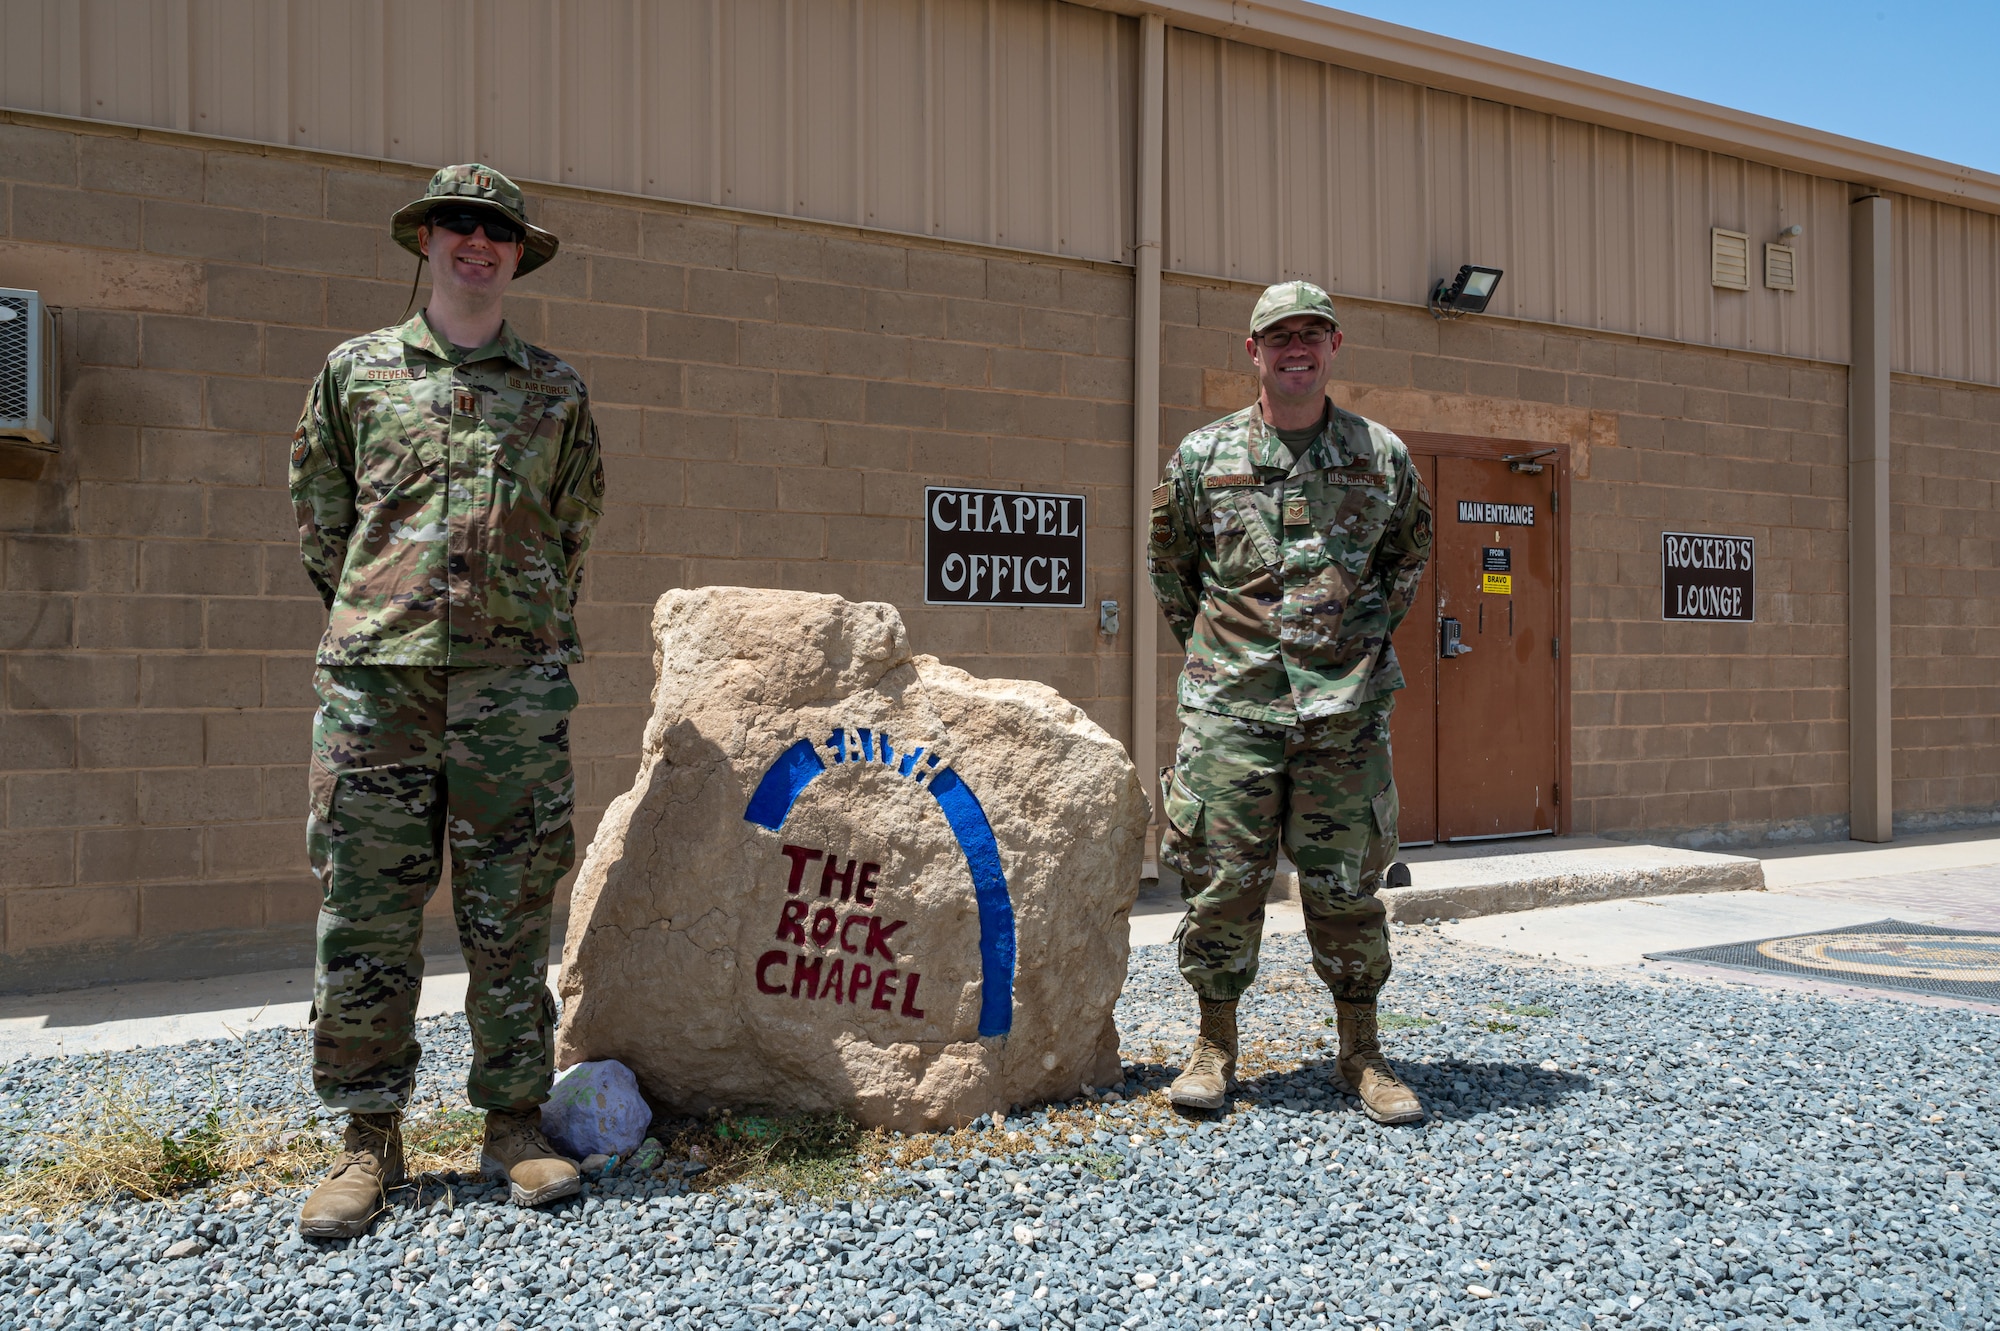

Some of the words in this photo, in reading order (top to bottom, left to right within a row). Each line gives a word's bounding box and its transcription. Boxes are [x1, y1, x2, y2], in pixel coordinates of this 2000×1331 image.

[368, 368, 414, 380] STEVENS
[525, 381, 539, 392] AIR
[540, 383, 570, 395] FORCE
[931, 492, 1080, 538] CHAPEL
[1459, 501, 1483, 523] MAIN
[1485, 503, 1534, 525] ENTRANCE
[1489, 548, 1504, 557] FPCON
[1666, 536, 1752, 571] ROCKER'S
[941, 552, 1071, 600] OFFICE
[1487, 575, 1507, 584] BRAVO
[1677, 585, 1742, 617] LOUNGE
[782, 844, 881, 907] THE
[776, 899, 908, 962] ROCK
[756, 950, 925, 1019] CHAPEL
